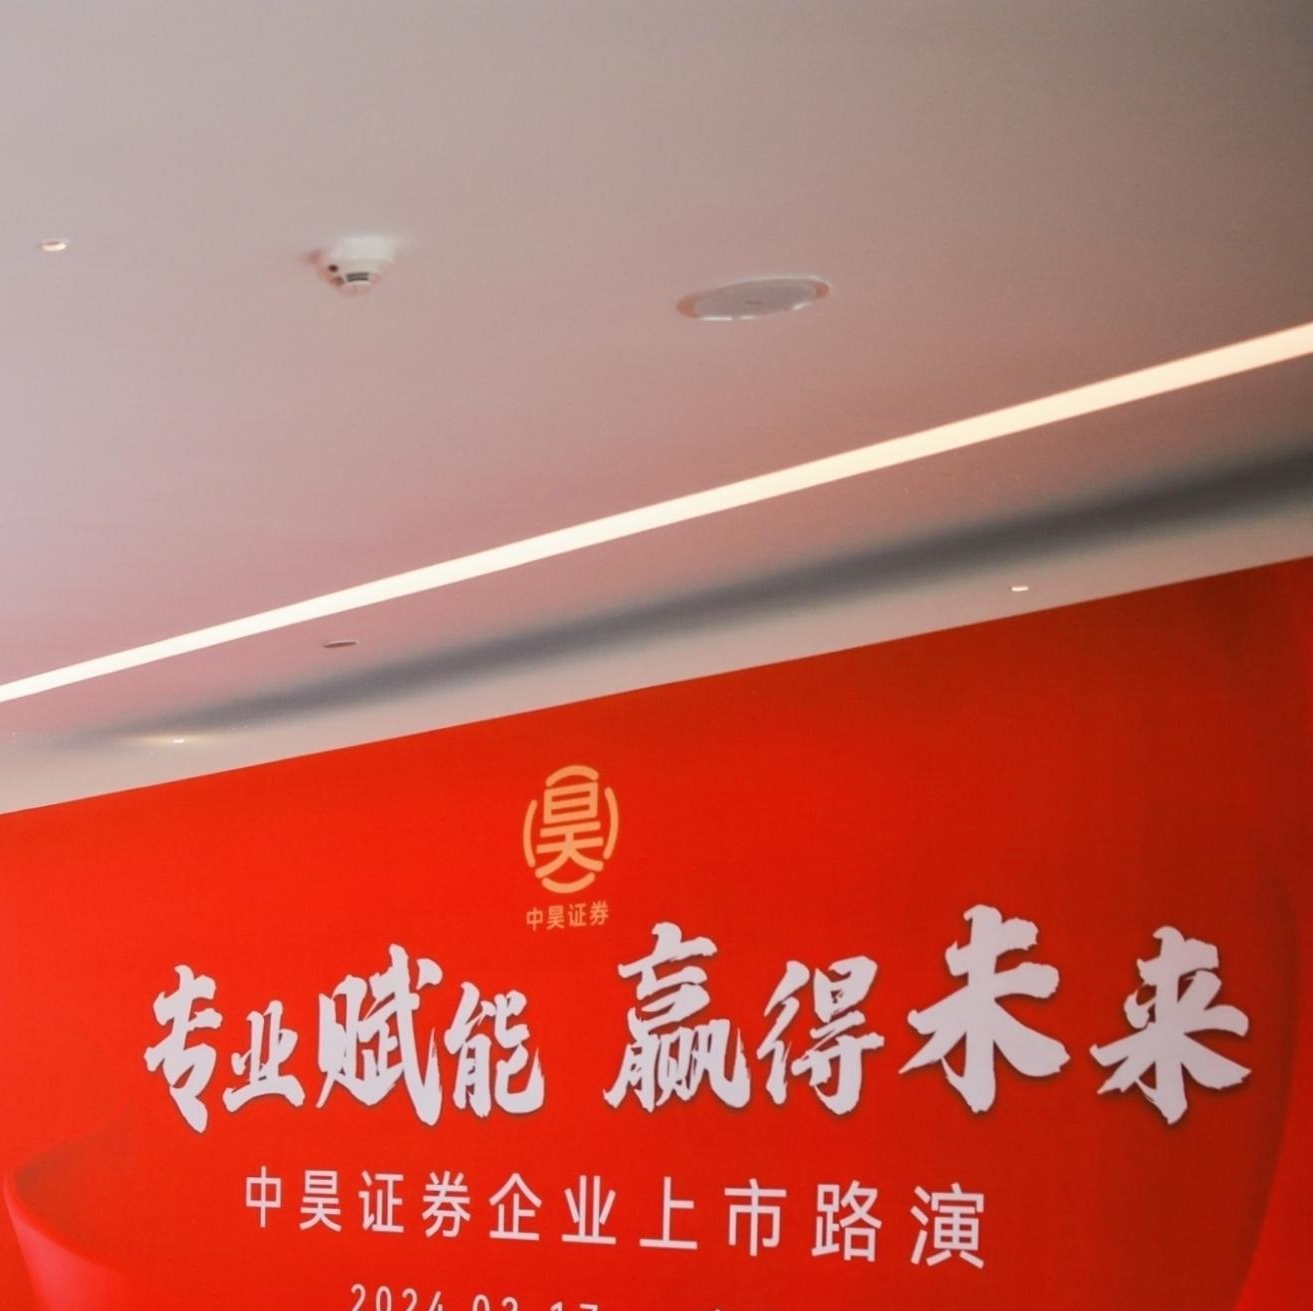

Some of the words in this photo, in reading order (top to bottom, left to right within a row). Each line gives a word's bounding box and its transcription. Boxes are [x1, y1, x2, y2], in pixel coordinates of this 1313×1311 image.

[526, 900, 609, 931] 中昊证券
[144, 943, 546, 1132] 专业赋能
[605, 904, 1252, 1126] 赢得未来
[243, 1167, 987, 1271] 中昊证券企业上市路演
